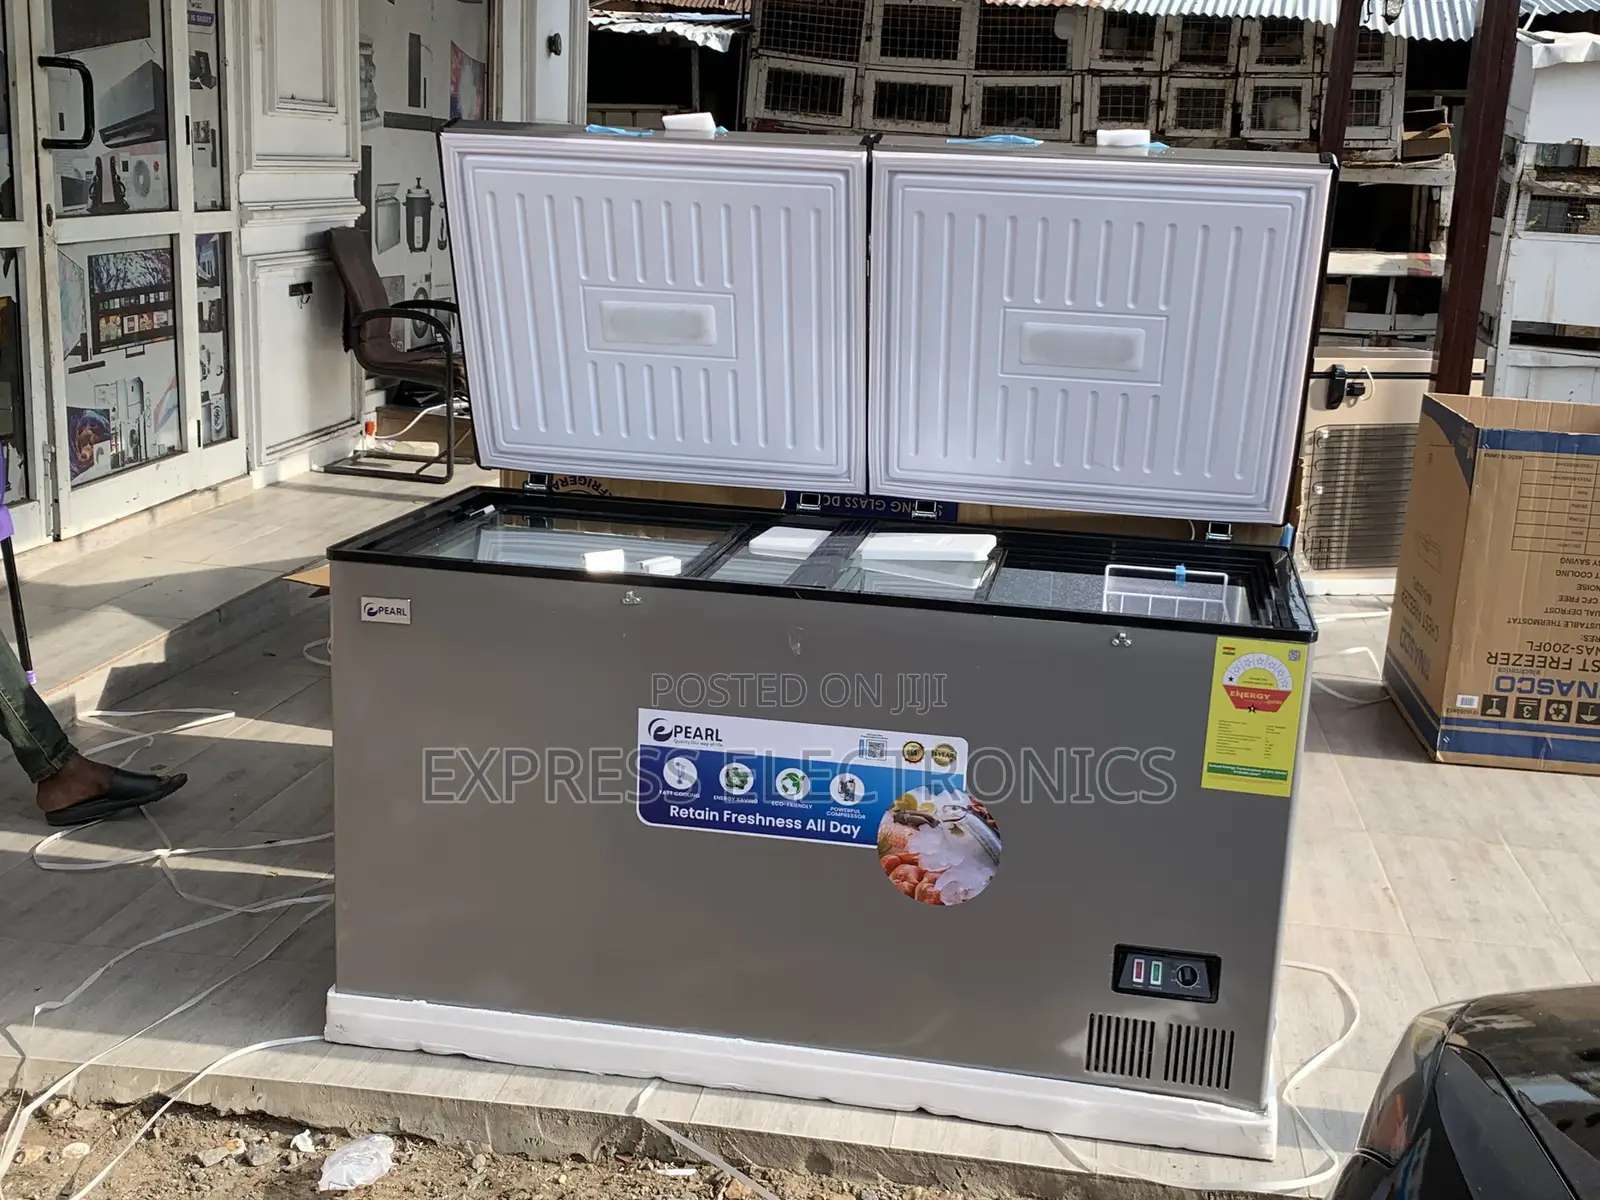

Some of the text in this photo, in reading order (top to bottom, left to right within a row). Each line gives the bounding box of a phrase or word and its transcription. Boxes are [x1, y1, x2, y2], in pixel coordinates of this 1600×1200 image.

[845, 497, 885, 510] GLASS
[1560, 557, 1590, 566] SAVING
[1555, 569, 1592, 579] COOLING
[1558, 594, 1599, 605] CFC FREE
[378, 606, 407, 617] PEARL
[1544, 607, 1582, 616] DEFROST
[1507, 617, 1561, 628] THERMOSTAT
[1486, 651, 1573, 671] FREEZER
[1495, 675, 1599, 699] NASCO
[1229, 690, 1271, 700] ENERGY
[1523, 706, 1533, 718] 3
[674, 725, 723, 742] PEARL
[771, 800, 813, 810] ECO-FRIENDLY
[830, 806, 861, 814] POWERFUL
[825, 811, 867, 820] COMPRESSOR
[669, 805, 862, 839] Retain Freshness All Day
